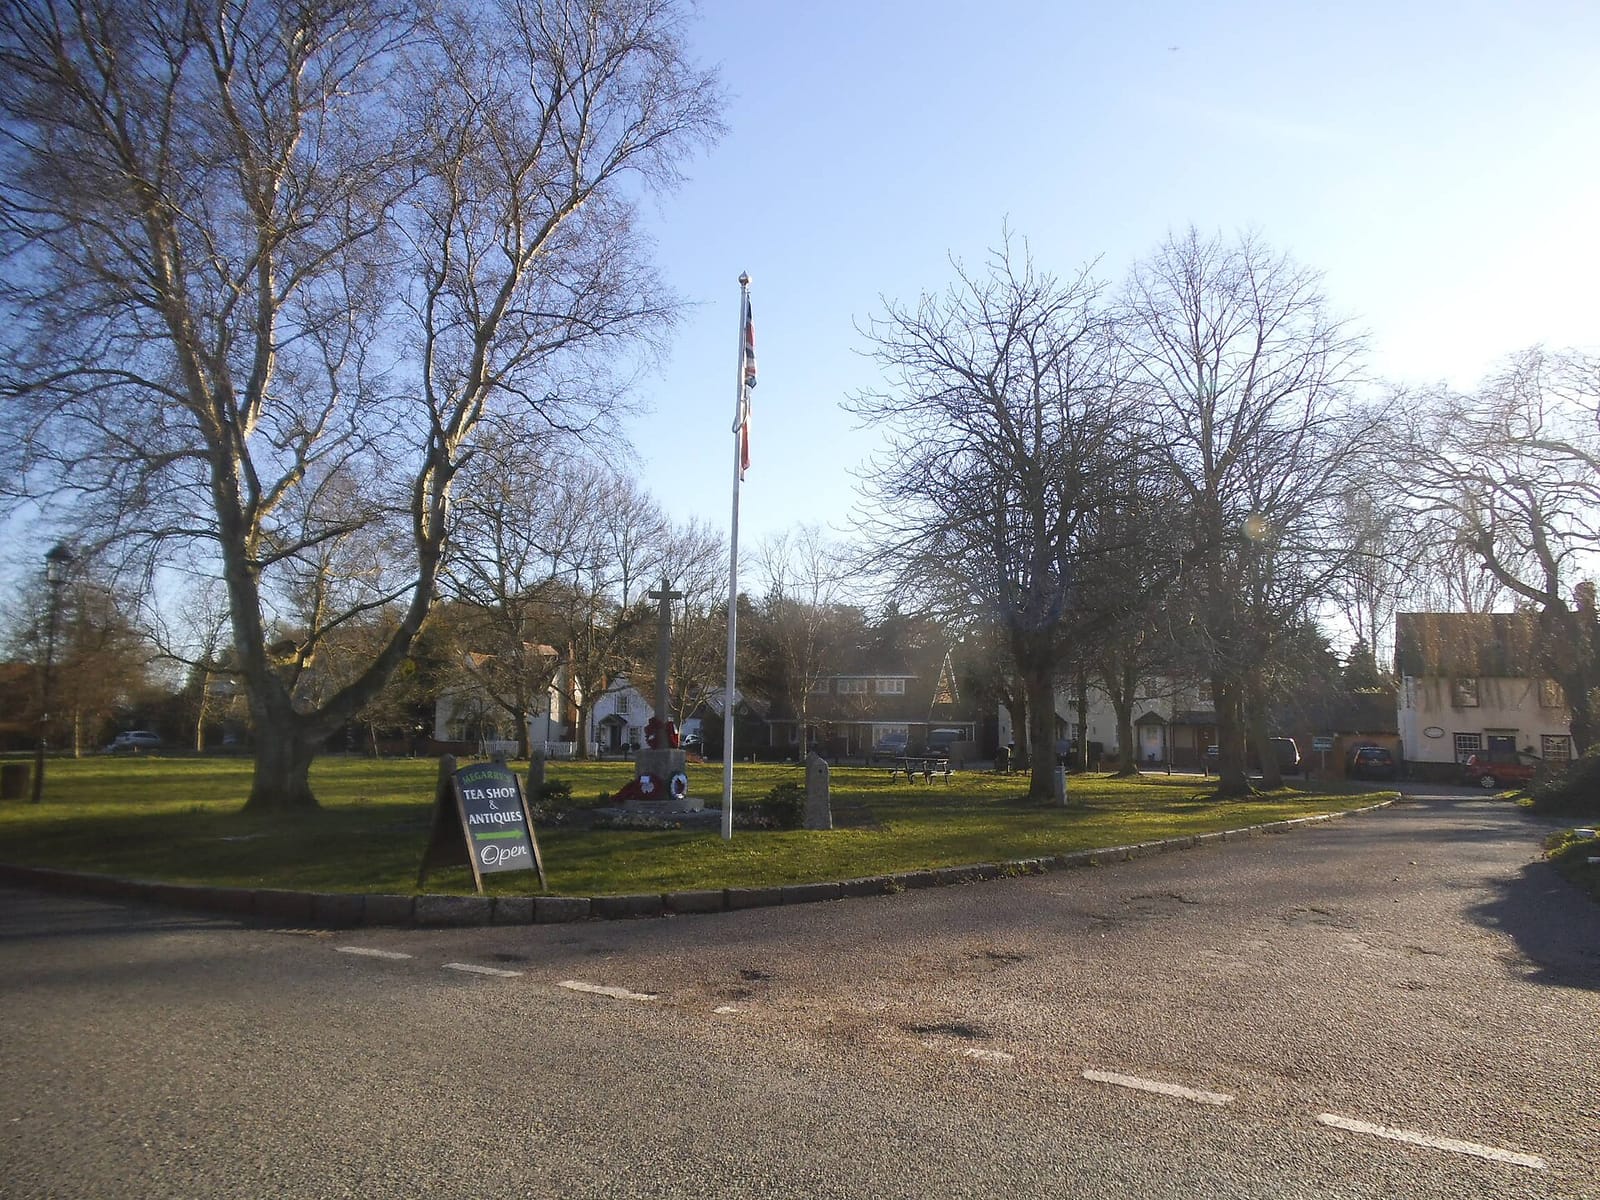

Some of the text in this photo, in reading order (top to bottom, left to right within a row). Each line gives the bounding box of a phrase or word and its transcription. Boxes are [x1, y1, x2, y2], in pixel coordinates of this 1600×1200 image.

[463, 787, 516, 800] TEA SHOP
[488, 800, 499, 810] &
[469, 811, 523, 825] ANTIQUES
[480, 844, 528, 866] Open
